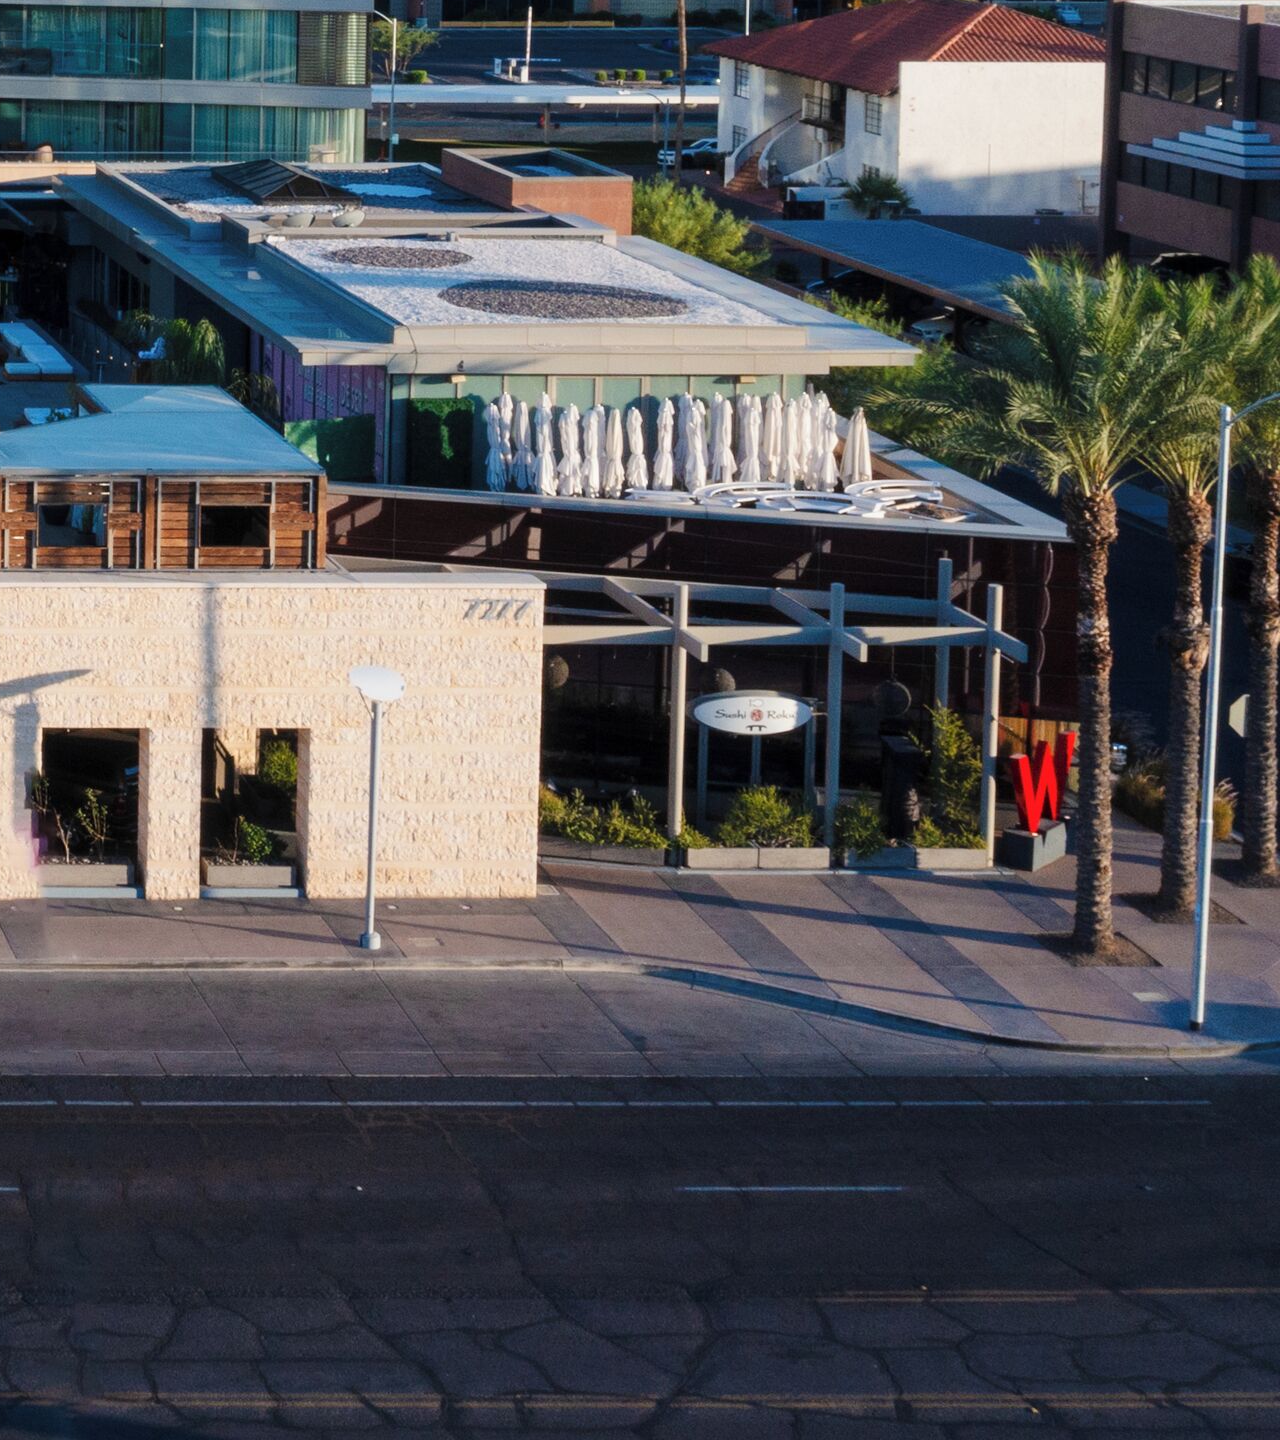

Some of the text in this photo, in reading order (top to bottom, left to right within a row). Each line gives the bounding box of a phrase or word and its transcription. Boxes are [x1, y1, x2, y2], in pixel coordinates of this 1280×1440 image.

[715, 709, 795, 719] Sushi Roku
[1009, 730, 1077, 833] W
